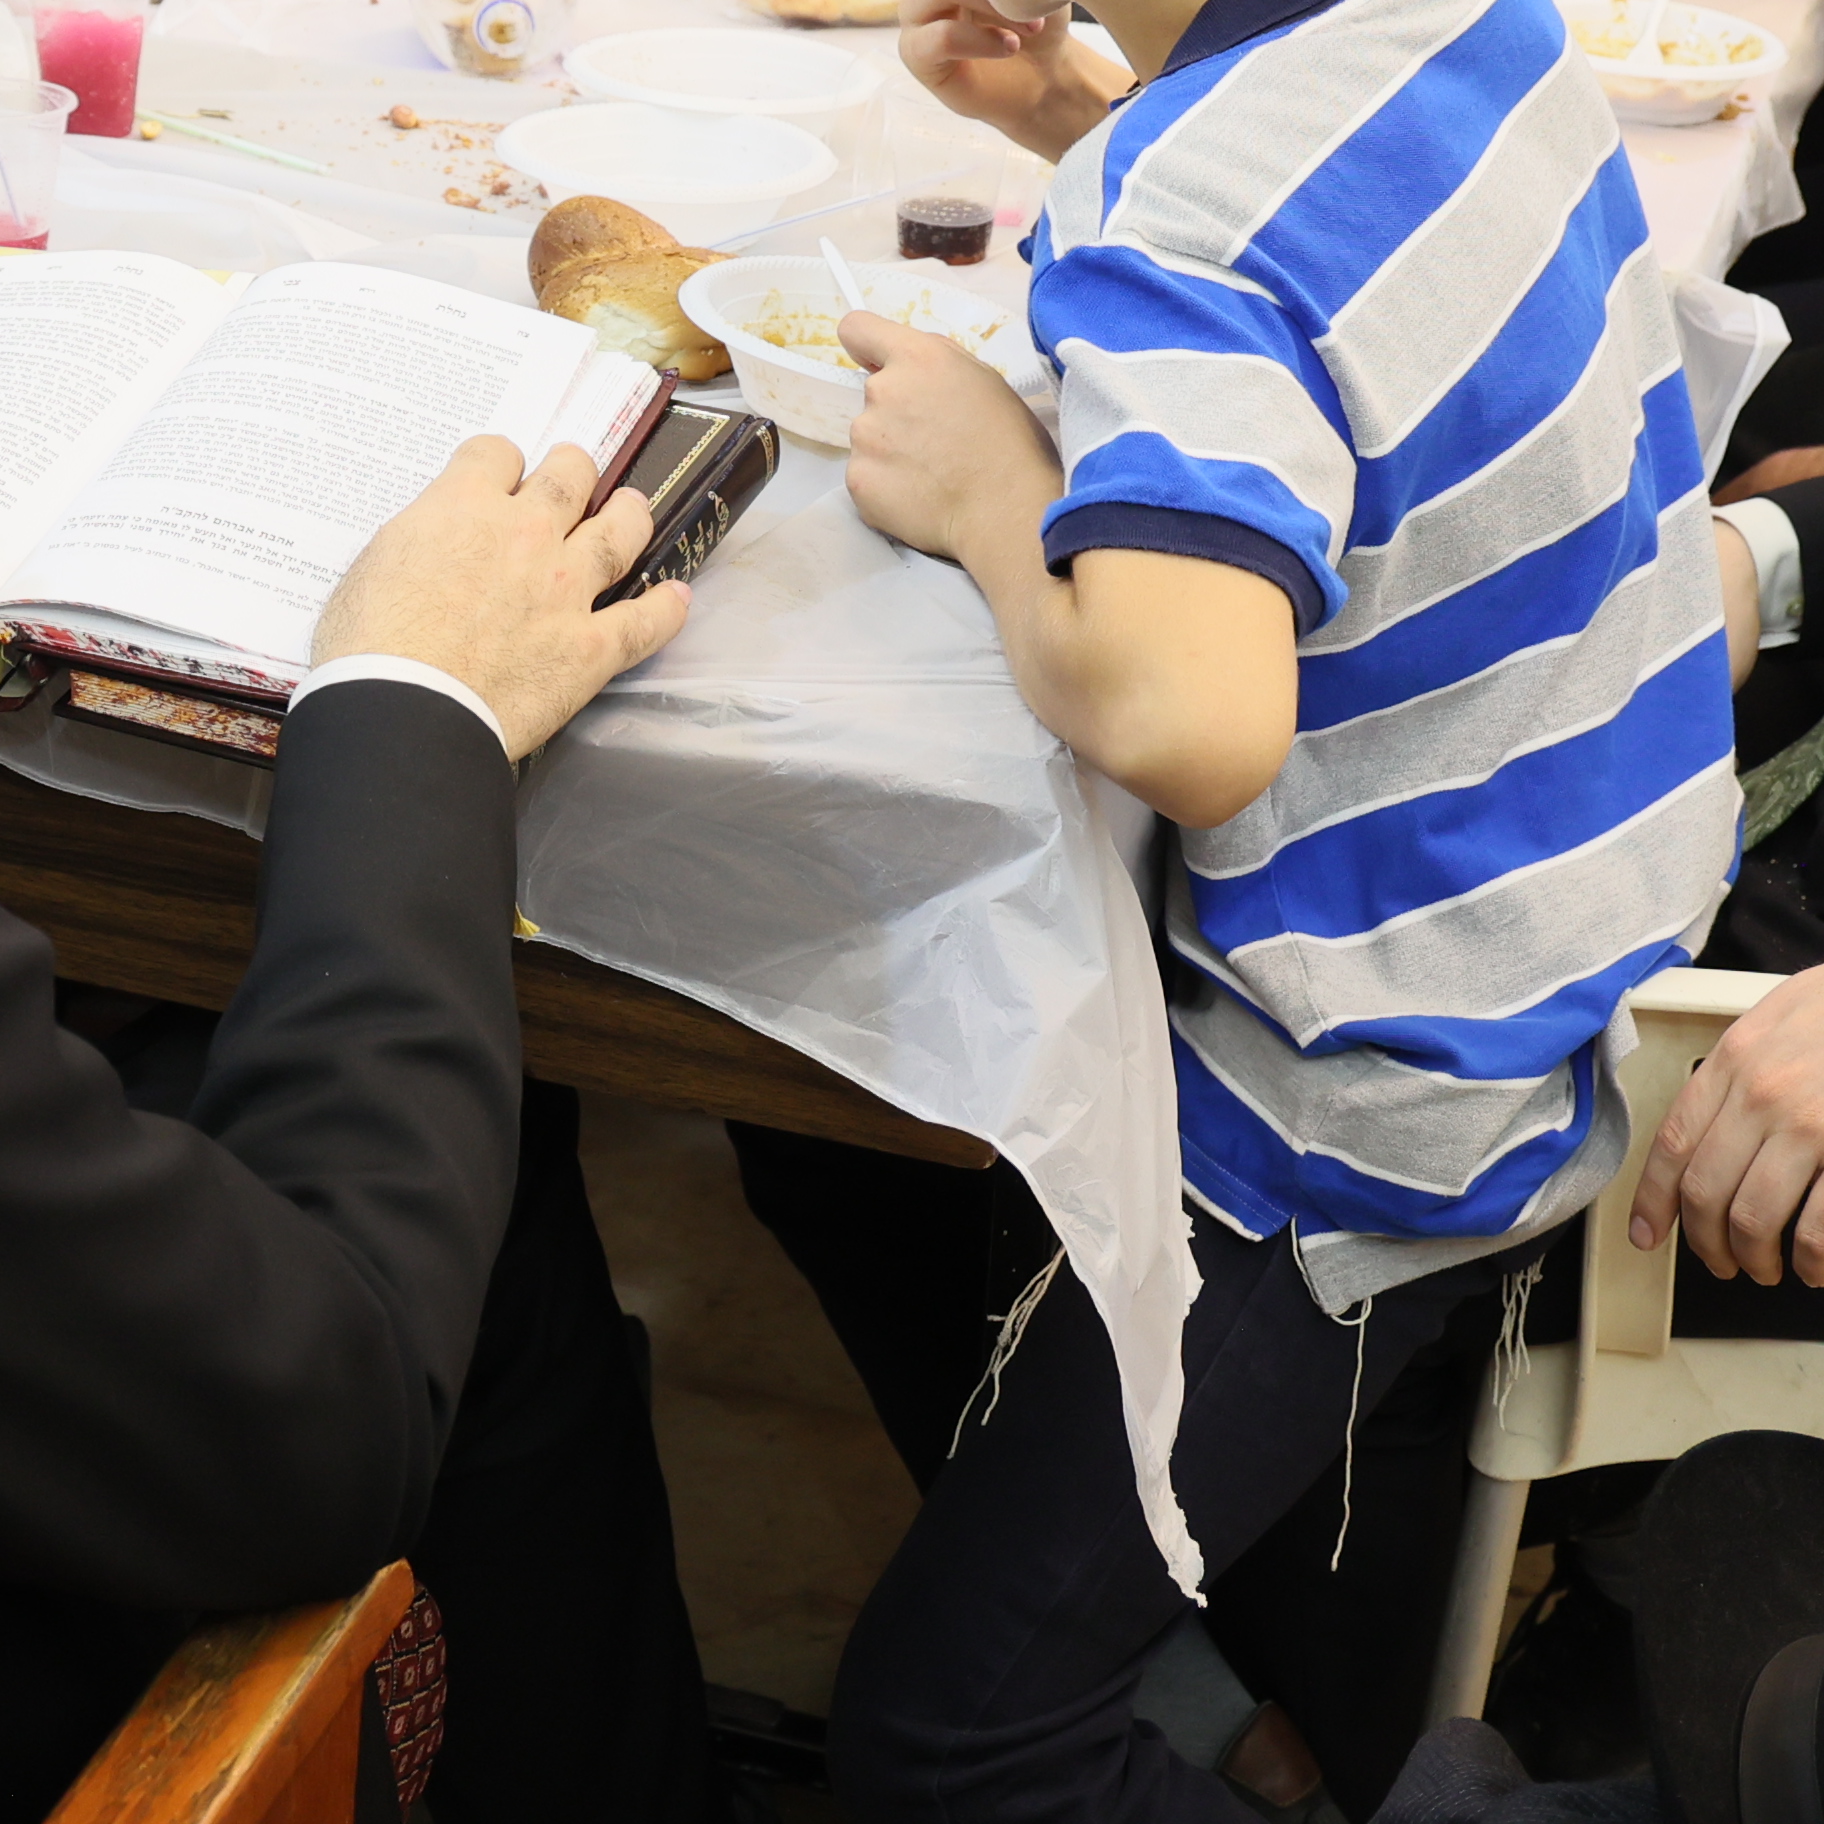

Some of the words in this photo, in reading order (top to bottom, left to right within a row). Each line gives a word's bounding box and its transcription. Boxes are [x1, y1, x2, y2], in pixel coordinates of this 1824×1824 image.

[113, 265, 144, 276] נחלת
[435, 304, 467, 319] נחלת
[405, 326, 432, 338] אברהם
[130, 524, 153, 533] ממני
[145, 517, 178, 529] מאומה
[212, 517, 255, 535] אברהם
[159, 528, 185, 538] יחידך
[194, 527, 217, 538] תעש
[189, 536, 206, 545] את
[219, 533, 237, 544] ואל
[258, 531, 295, 548] אהבת
[211, 541, 227, 551] בנך
[240, 540, 263, 552] הנער
[232, 548, 248, 557] את
[265, 547, 279, 558] אל
[282, 554, 298, 562] ידך
[252, 554, 283, 569] חשכת
[300, 560, 329, 574] תשלח
[287, 566, 305, 576] ולא
[309, 573, 333, 584] אתה
[273, 586, 294, 597] כתיב
